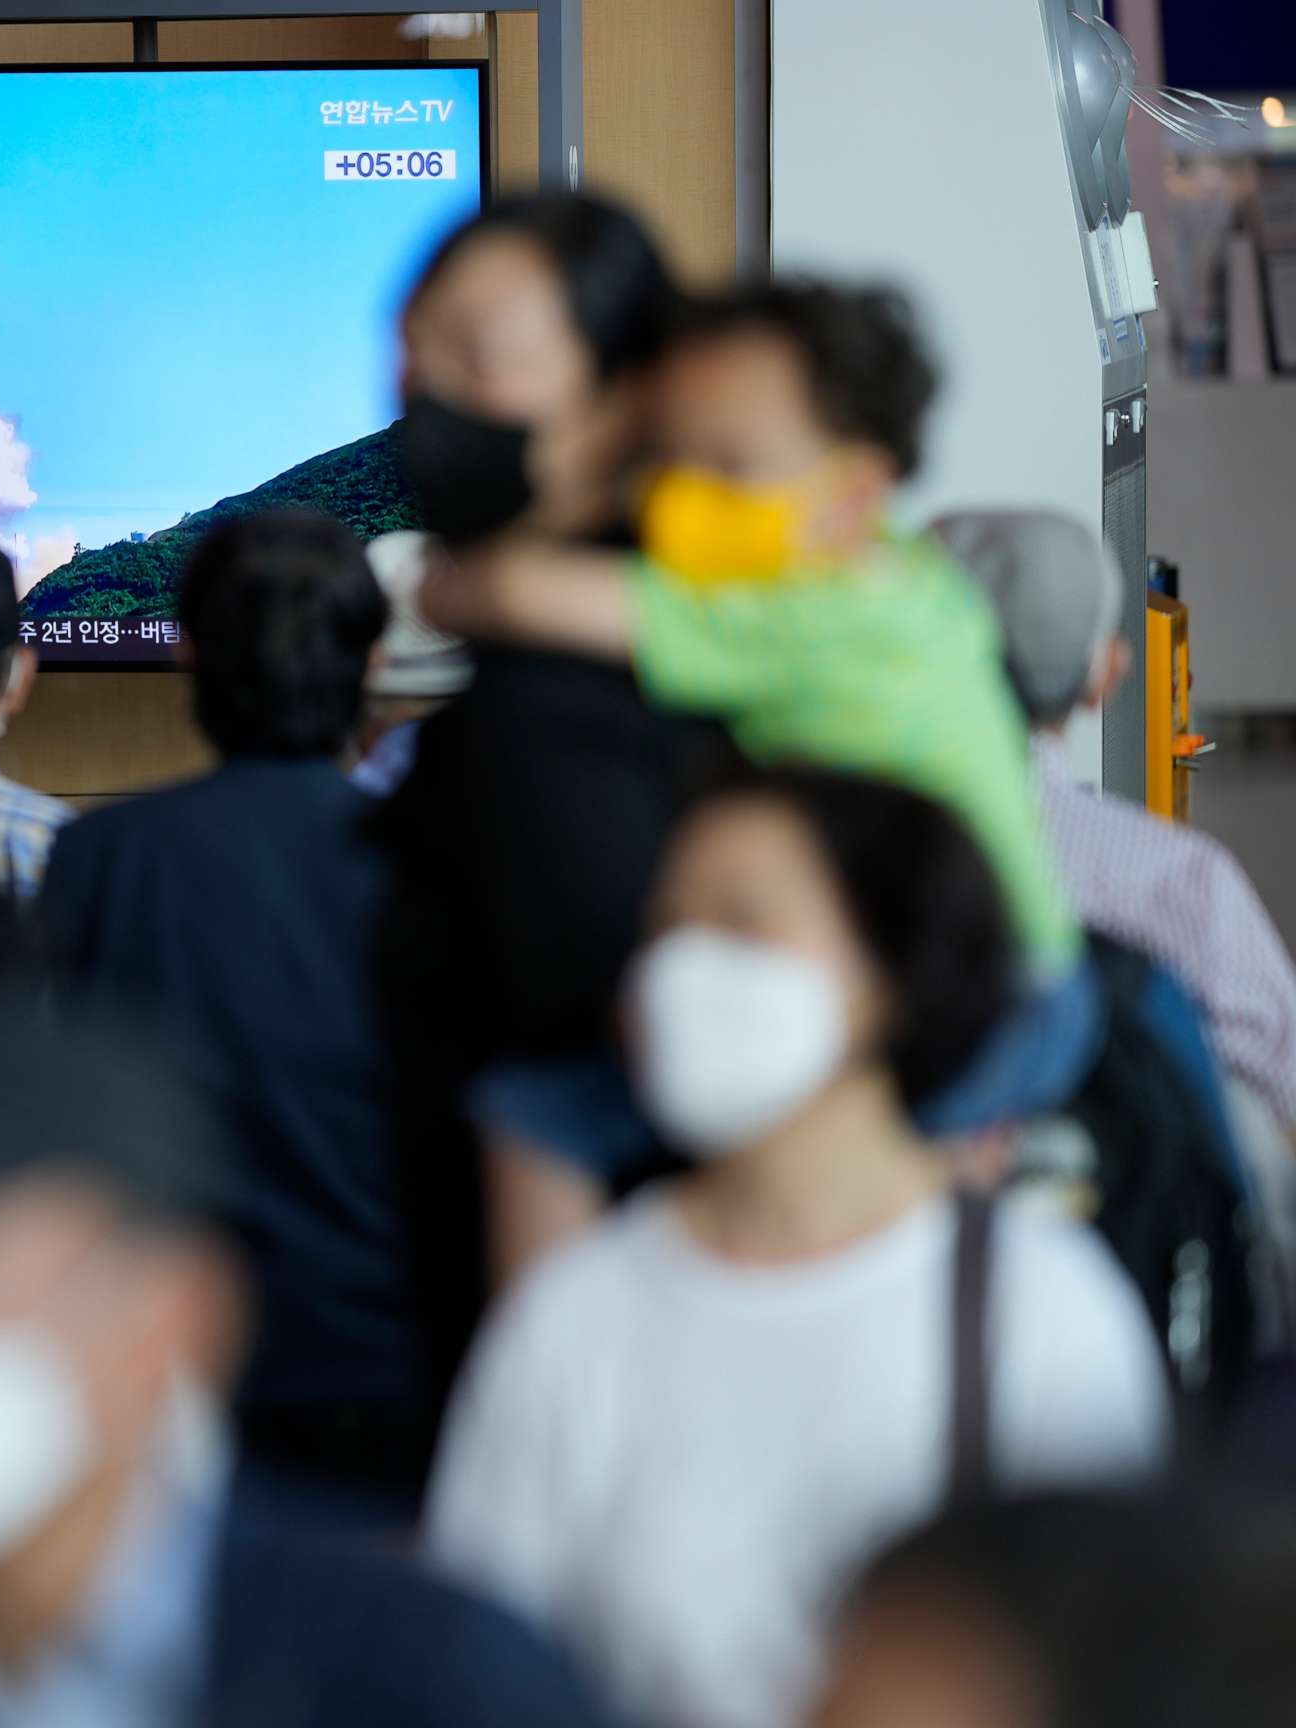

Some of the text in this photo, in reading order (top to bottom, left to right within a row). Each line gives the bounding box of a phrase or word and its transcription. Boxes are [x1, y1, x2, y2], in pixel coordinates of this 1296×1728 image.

[320, 100, 454, 125] 연합뉴스TV
[335, 151, 443, 178] +05:06
[41, 620, 72, 644] 2년
